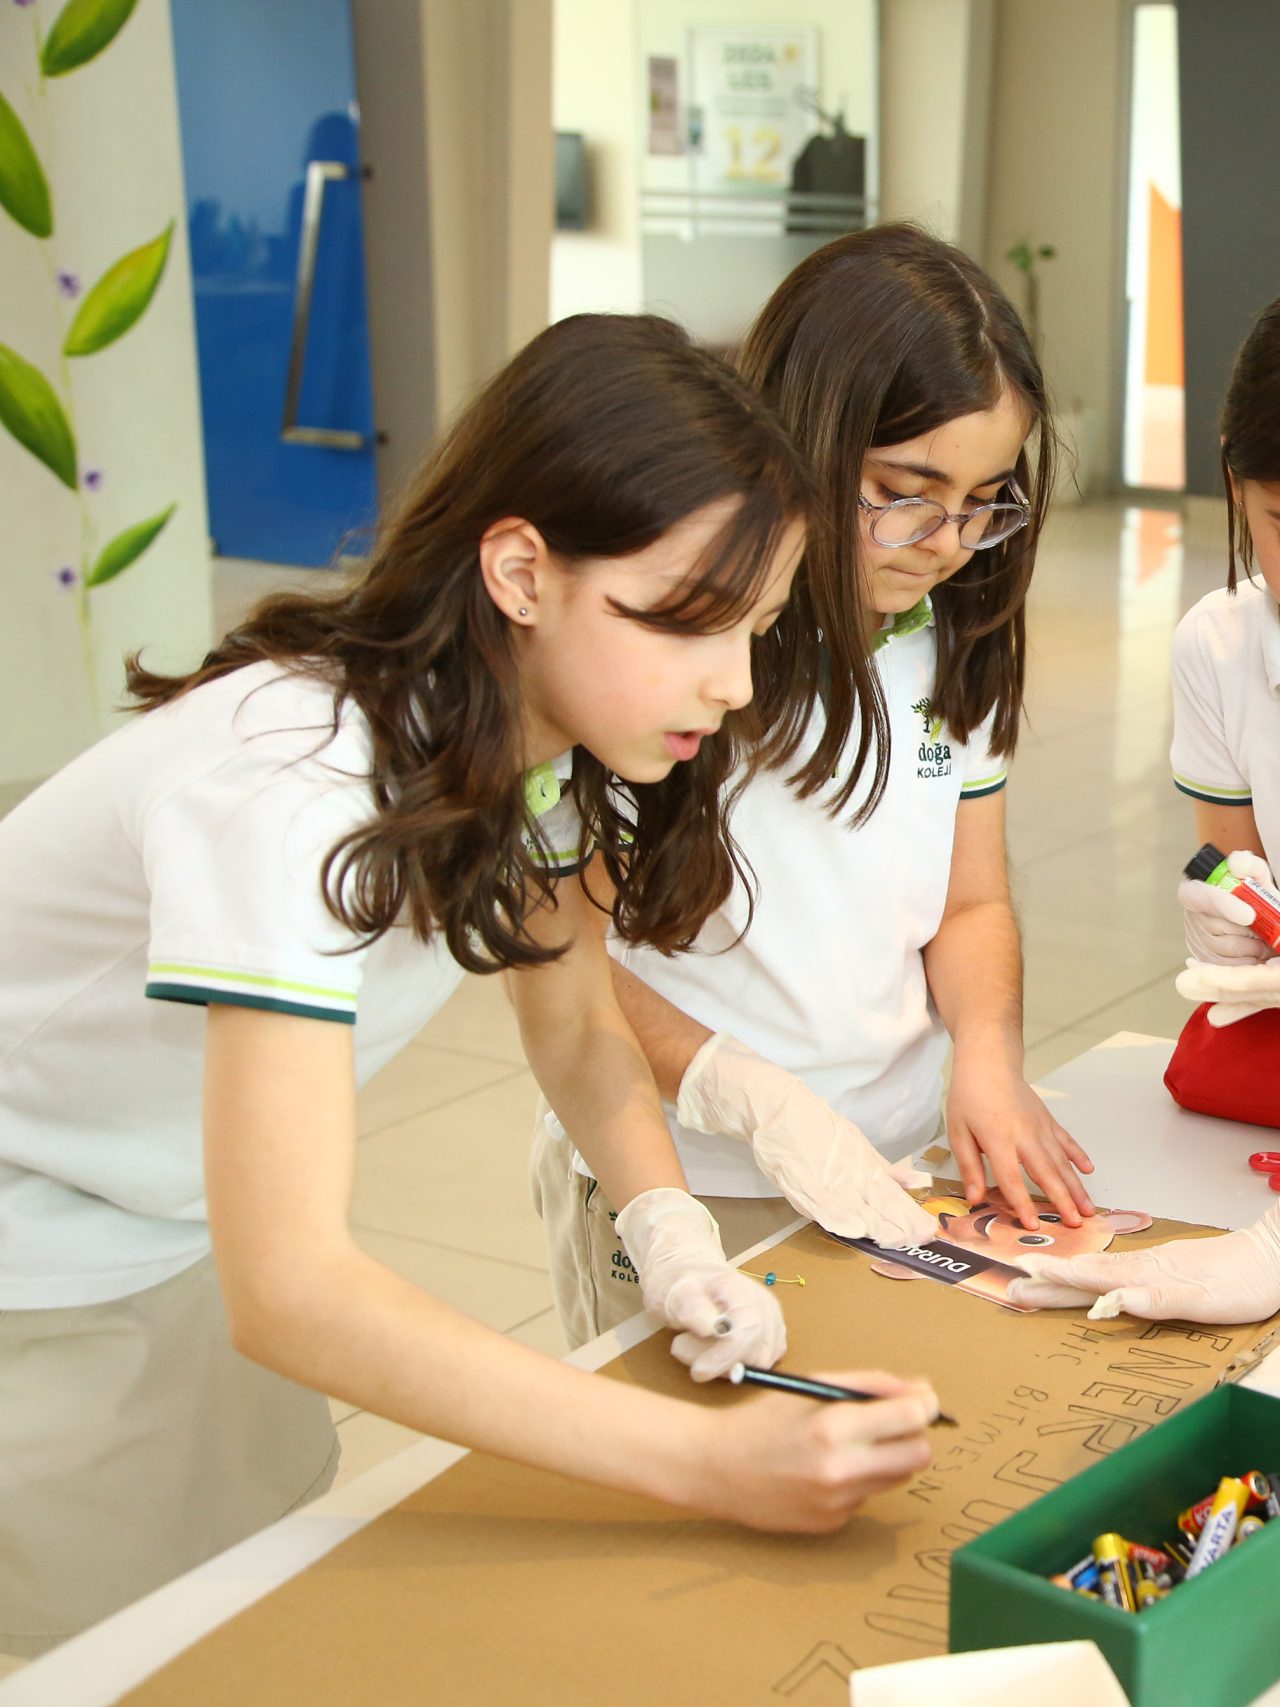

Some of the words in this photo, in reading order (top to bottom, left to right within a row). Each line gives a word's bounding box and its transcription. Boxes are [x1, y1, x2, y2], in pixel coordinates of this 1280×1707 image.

[725, 126, 783, 181] 12
[918, 742, 952, 765] doğa
[611, 1269, 640, 1284] KOLE
